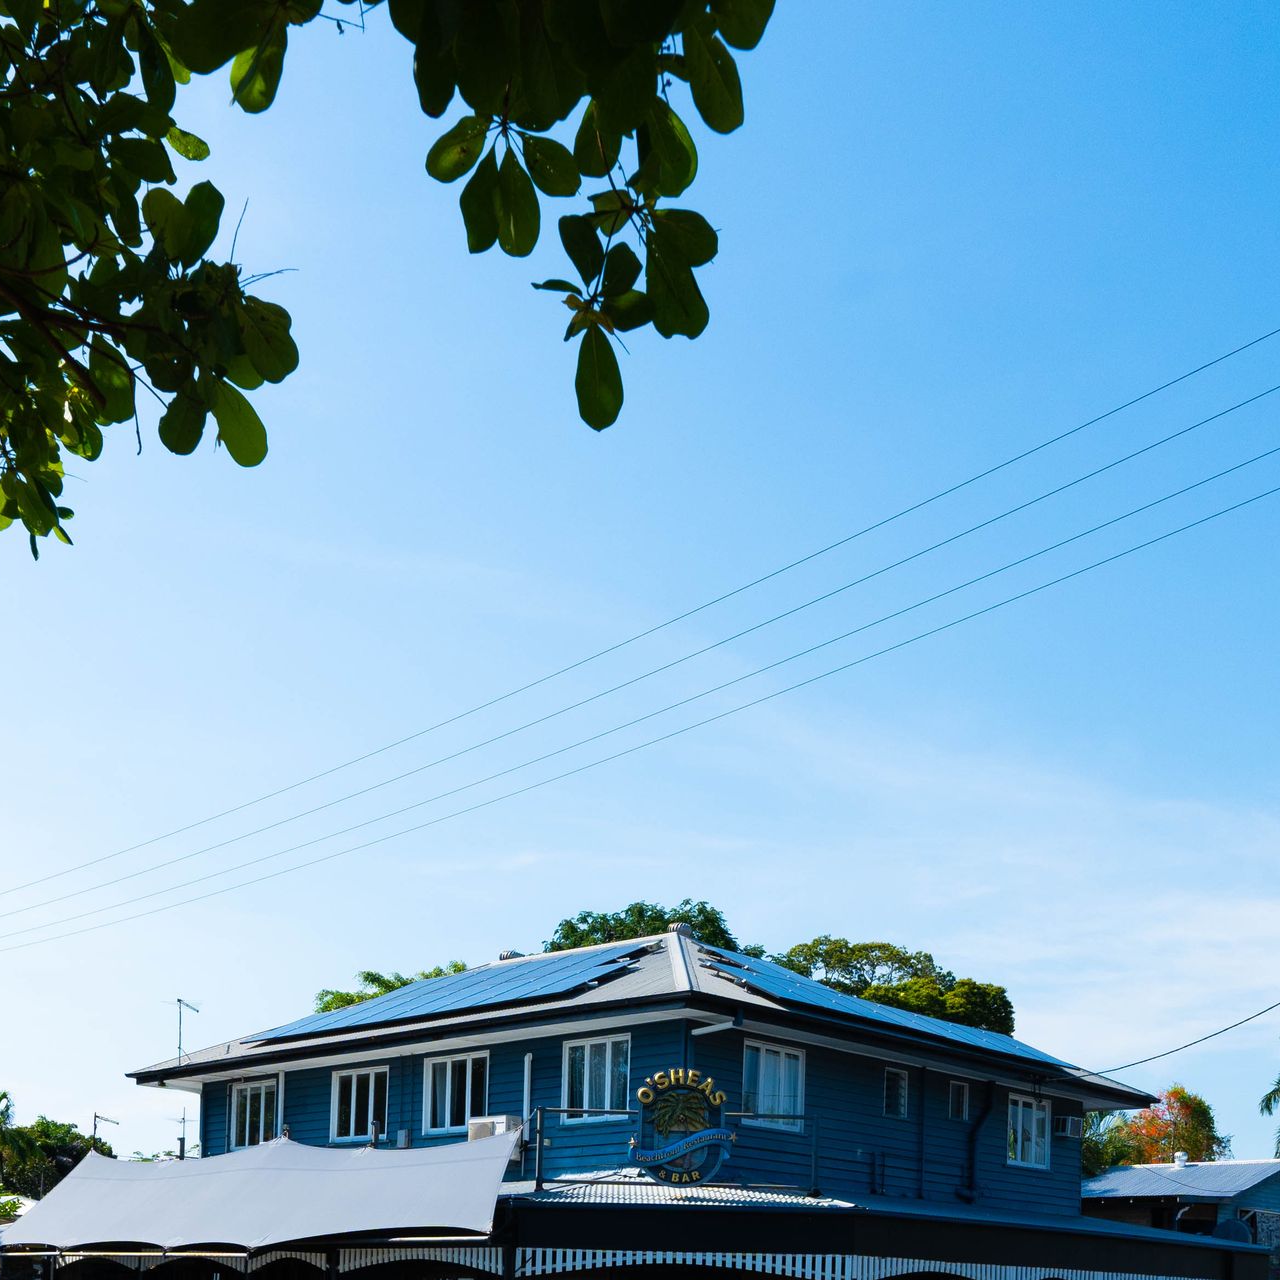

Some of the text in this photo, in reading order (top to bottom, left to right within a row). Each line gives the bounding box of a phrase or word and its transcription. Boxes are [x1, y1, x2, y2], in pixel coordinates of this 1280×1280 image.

[637, 1067, 728, 1106] O'SHEAS
[683, 1134, 727, 1150] Restaurant
[658, 1169, 701, 1183] & BAR
